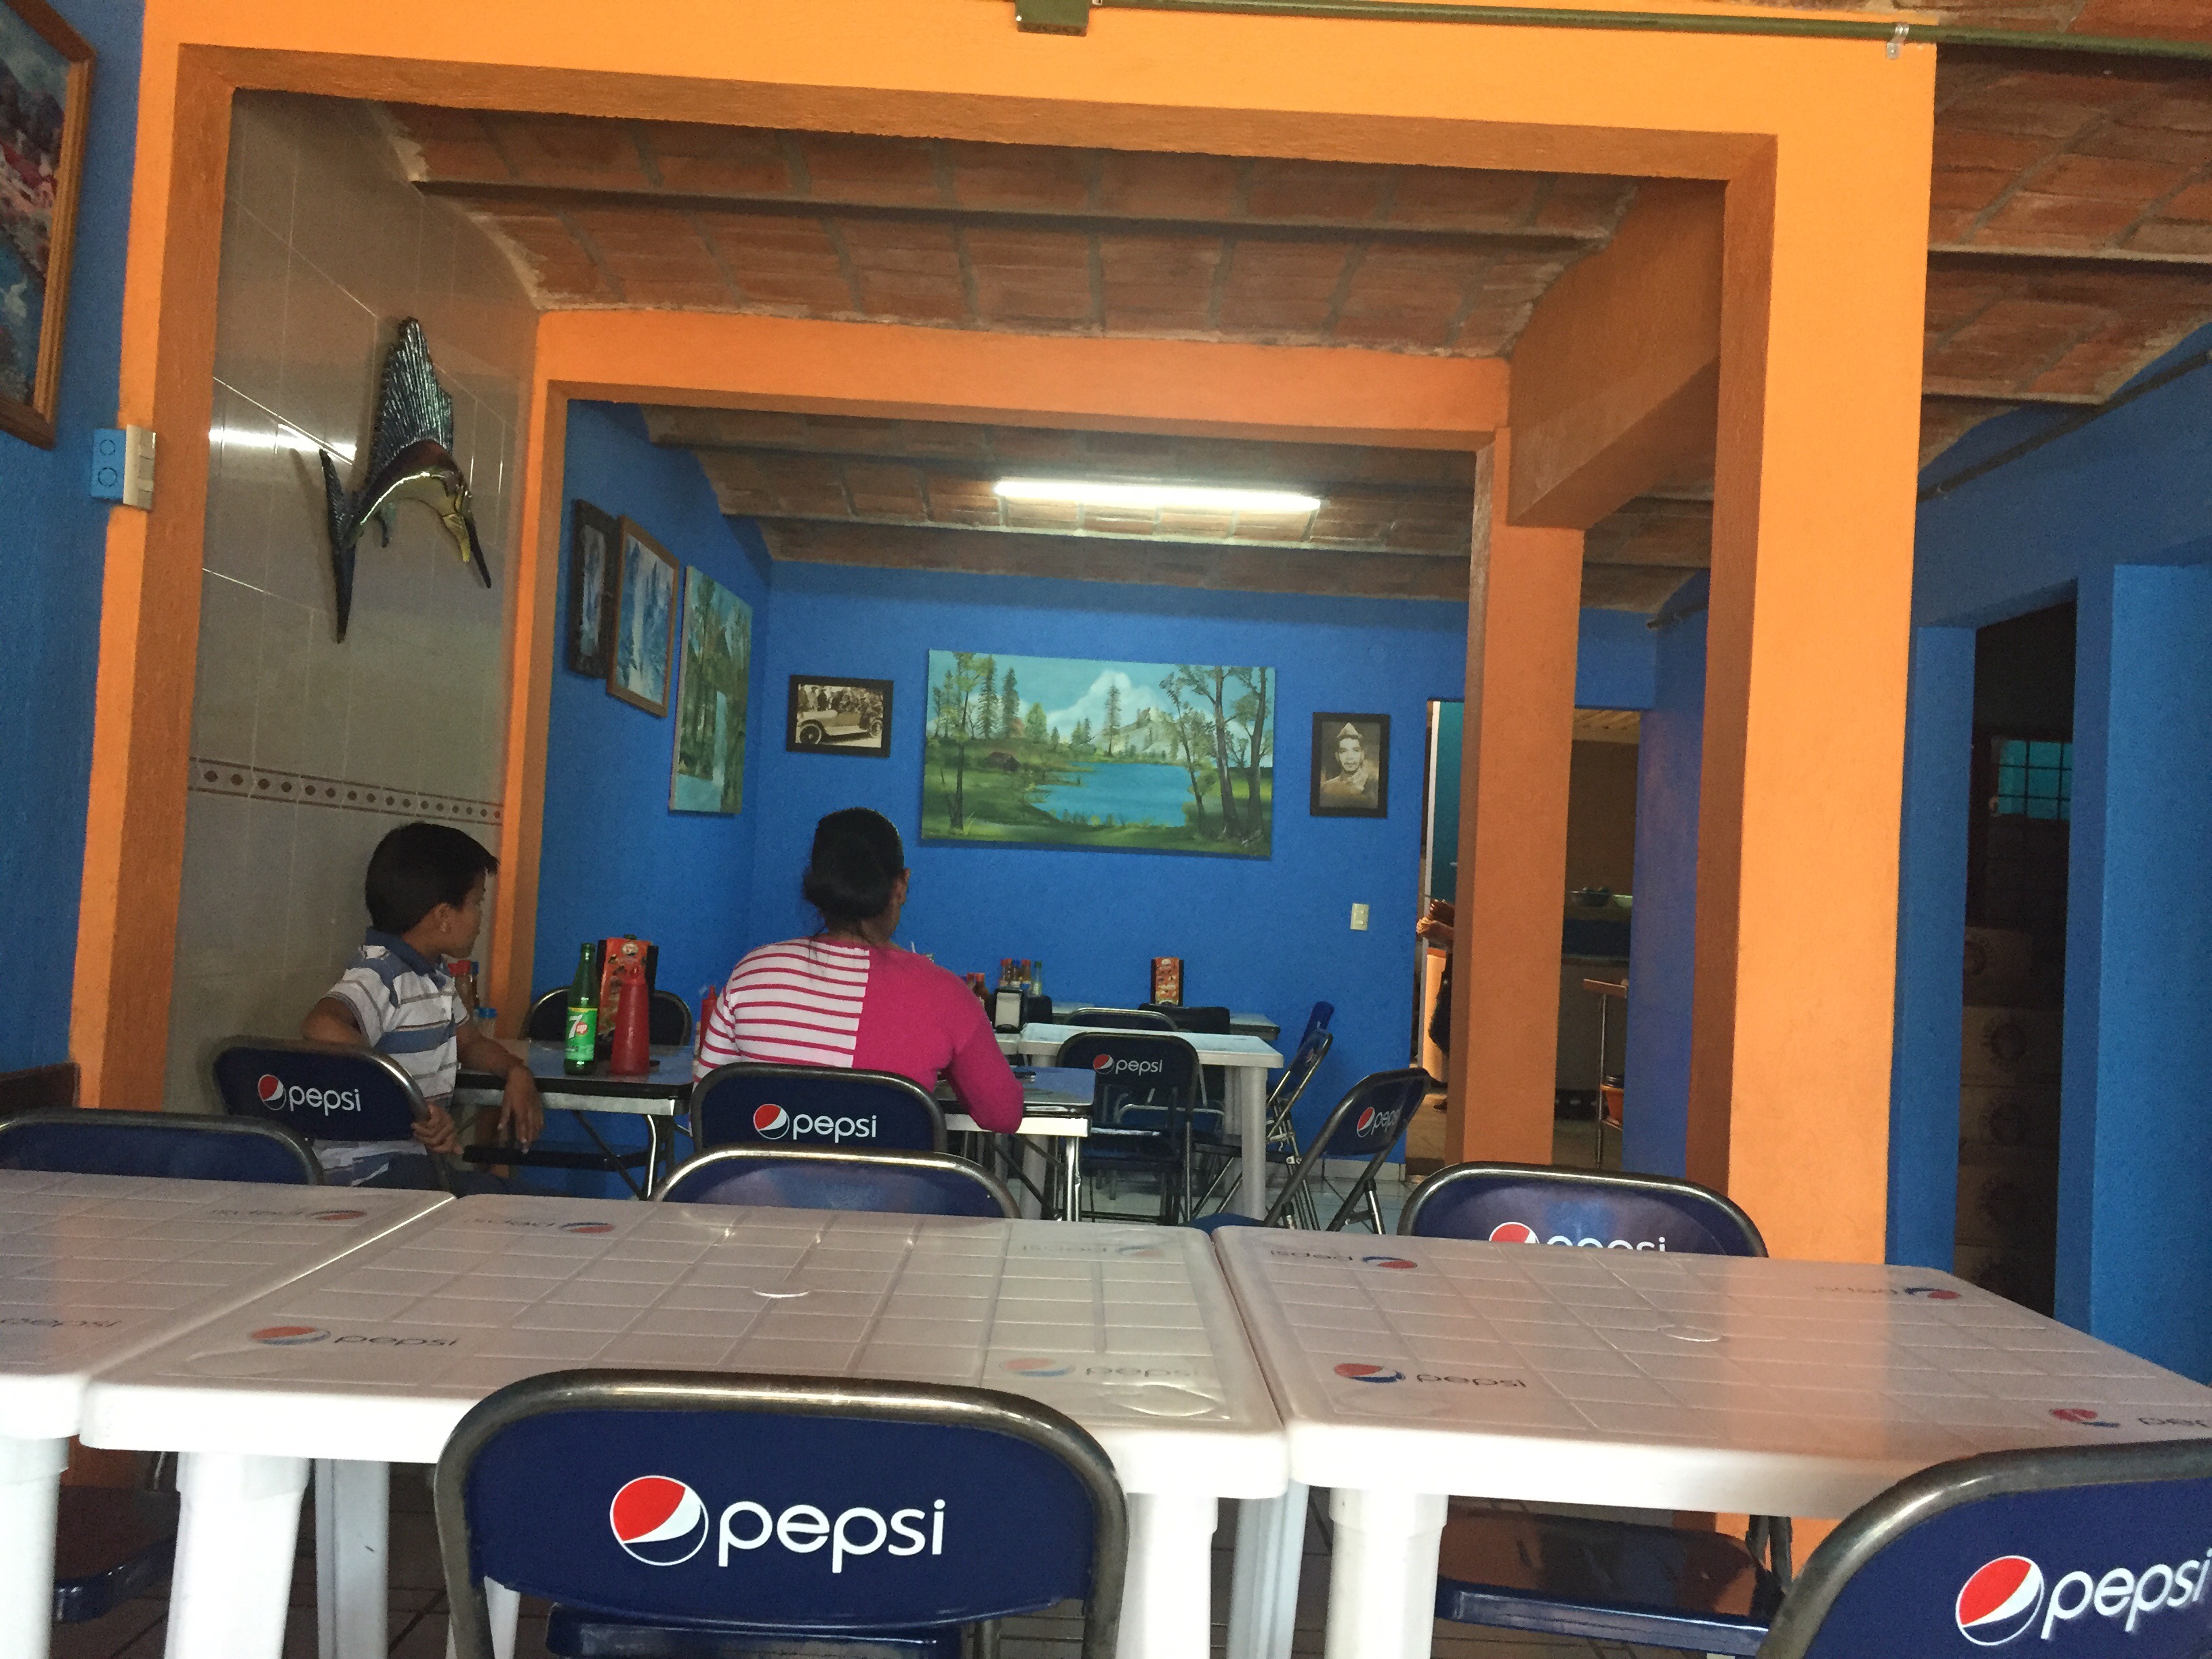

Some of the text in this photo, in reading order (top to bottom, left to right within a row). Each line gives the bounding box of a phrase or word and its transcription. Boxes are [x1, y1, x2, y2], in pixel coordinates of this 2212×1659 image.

[1115, 1059, 1163, 1076] pepsi
[289, 1086, 361, 1117] pepsi
[792, 1114, 877, 1144] pepsi
[718, 1498, 945, 1574] pepsi
[2040, 1547, 2212, 1641] pepsi
